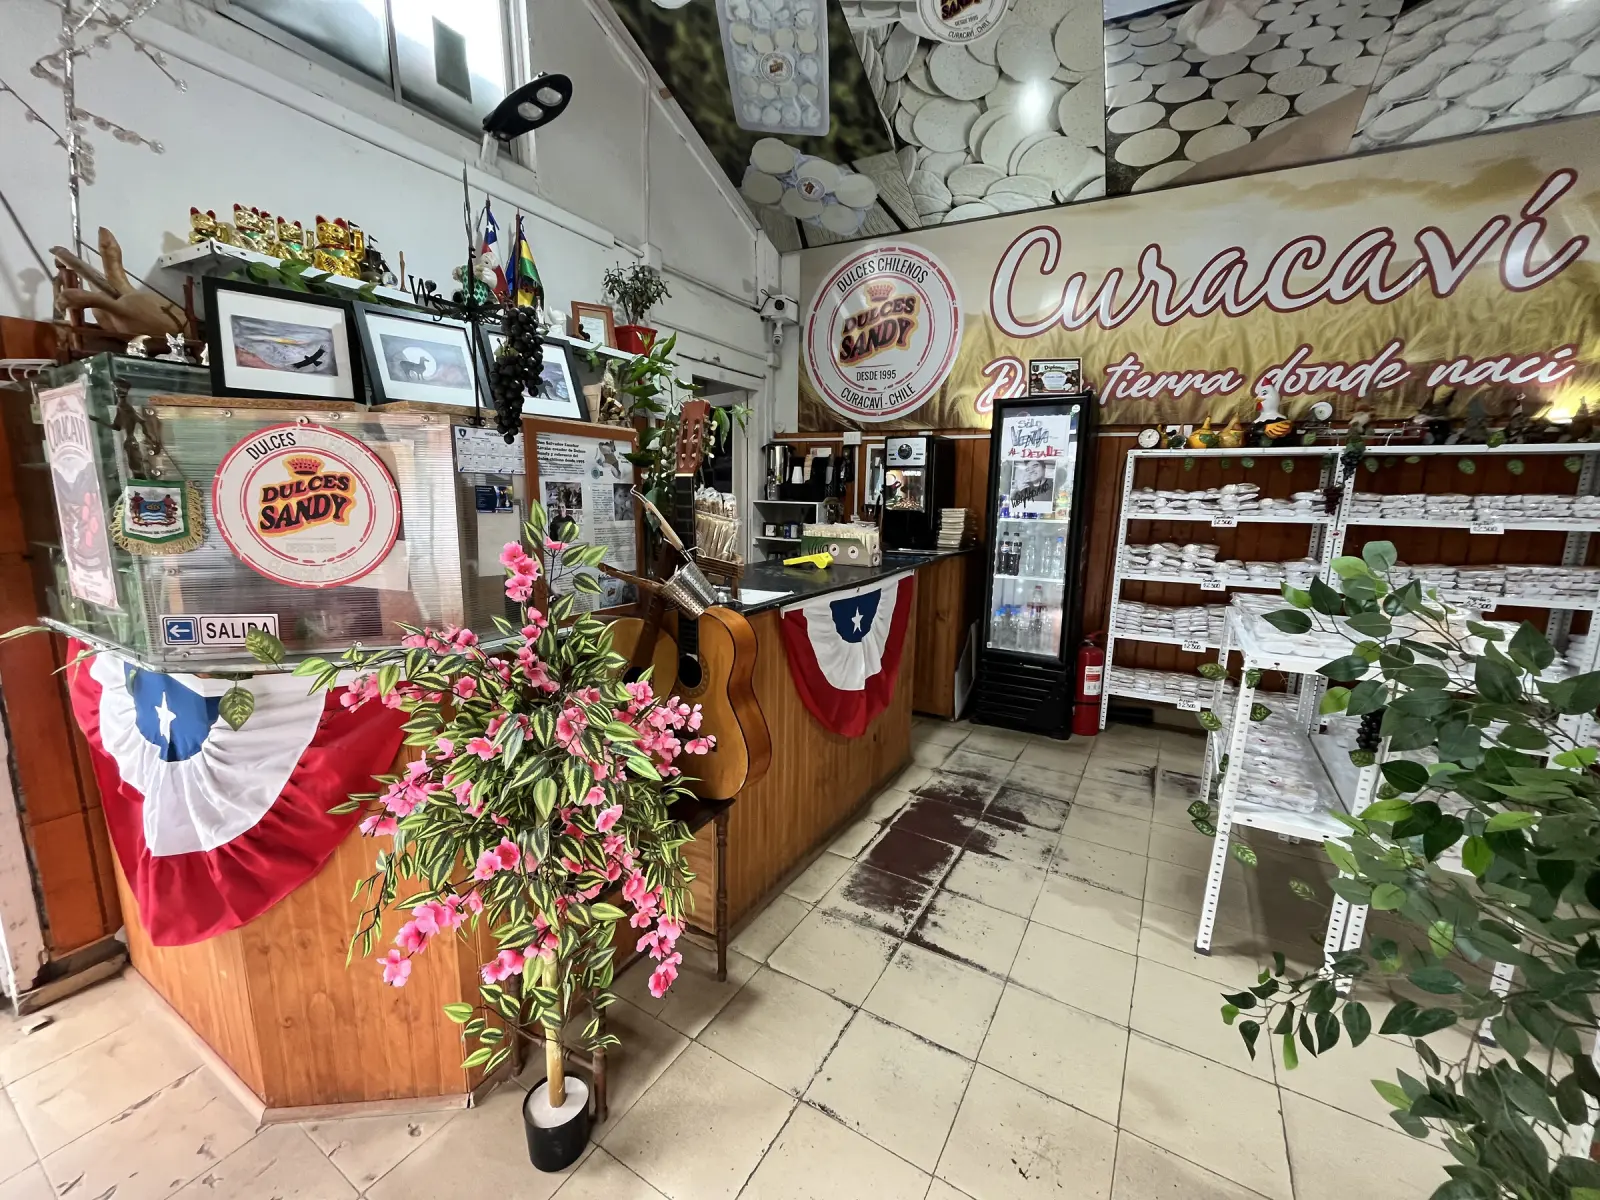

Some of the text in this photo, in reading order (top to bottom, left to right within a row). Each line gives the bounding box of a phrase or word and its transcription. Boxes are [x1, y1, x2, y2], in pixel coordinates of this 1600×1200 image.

[990, 168, 1589, 339] Curacaví
[837, 258, 928, 292] DULCES CHILENOS
[843, 296, 915, 335] DULCES
[840, 318, 914, 360] SANDY
[856, 369, 896, 382] DESDE 1995
[1099, 352, 1242, 405] tierra
[1257, 339, 1418, 397] donde
[841, 387, 884, 409] CURACAVÍ
[889, 382, 916, 406] CHILE
[246, 432, 296, 460] DULCES
[262, 475, 350, 502] DULCES
[260, 494, 347, 530] SANDY
